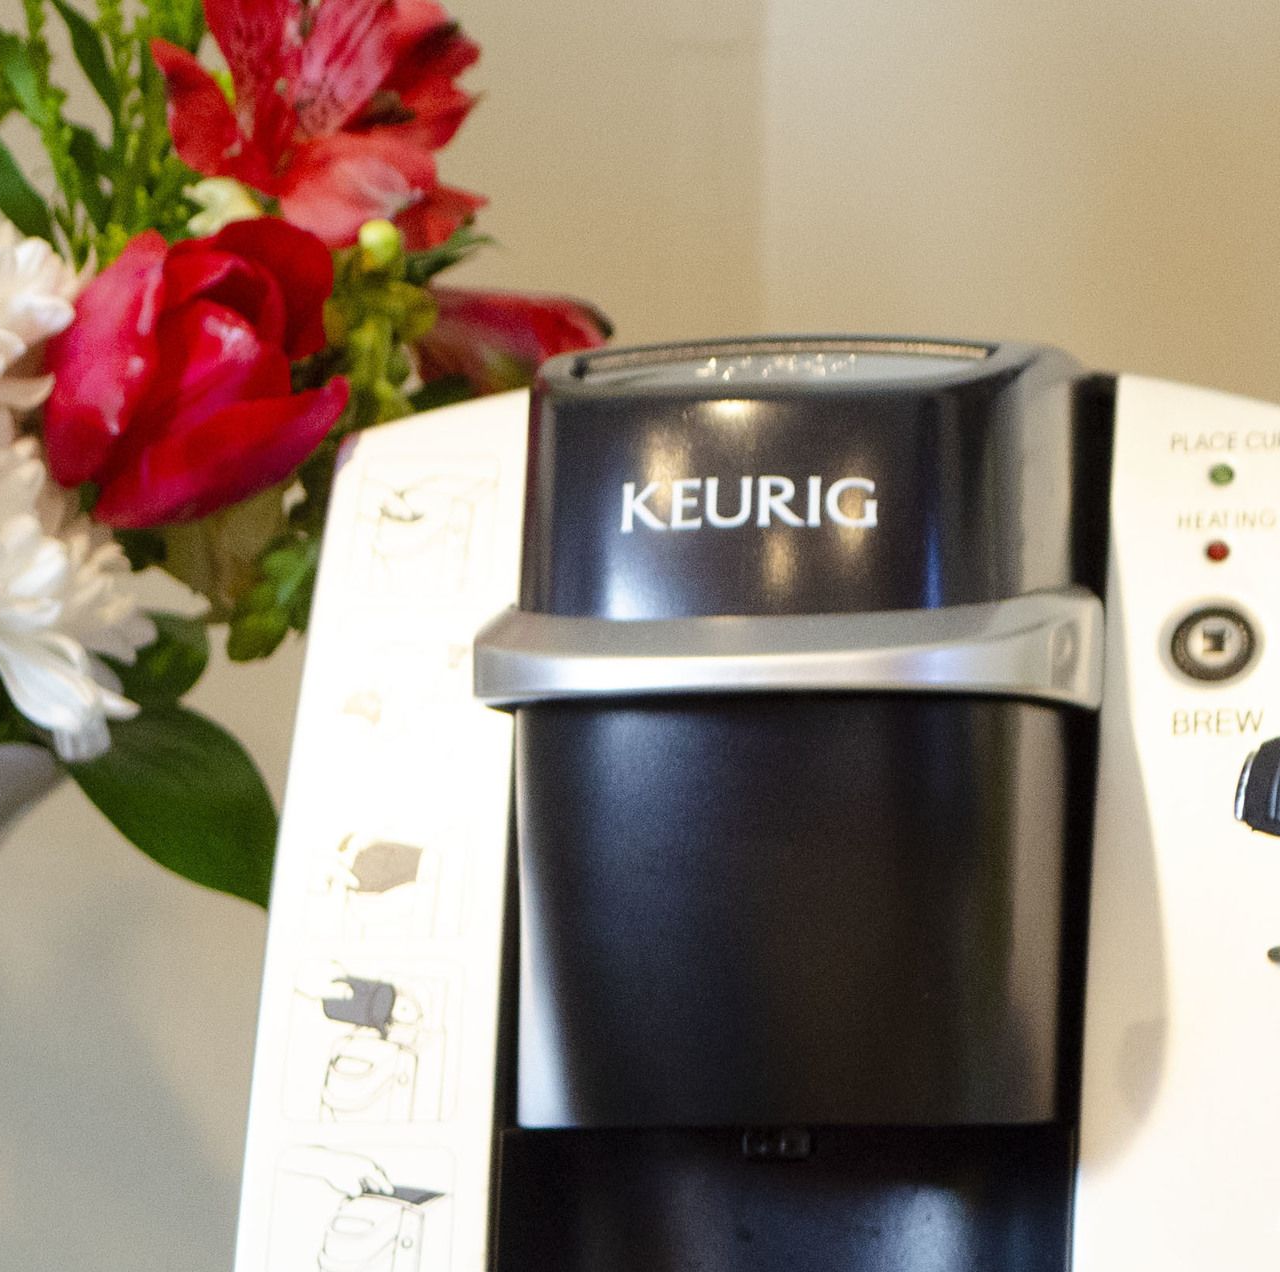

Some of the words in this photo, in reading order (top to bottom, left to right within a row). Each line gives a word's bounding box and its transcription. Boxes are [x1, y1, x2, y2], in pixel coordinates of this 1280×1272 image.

[1170, 430, 1238, 452] PLACE
[620, 475, 878, 533] KEURIG
[1177, 508, 1277, 530] HEATING
[1171, 707, 1265, 736] BREW
